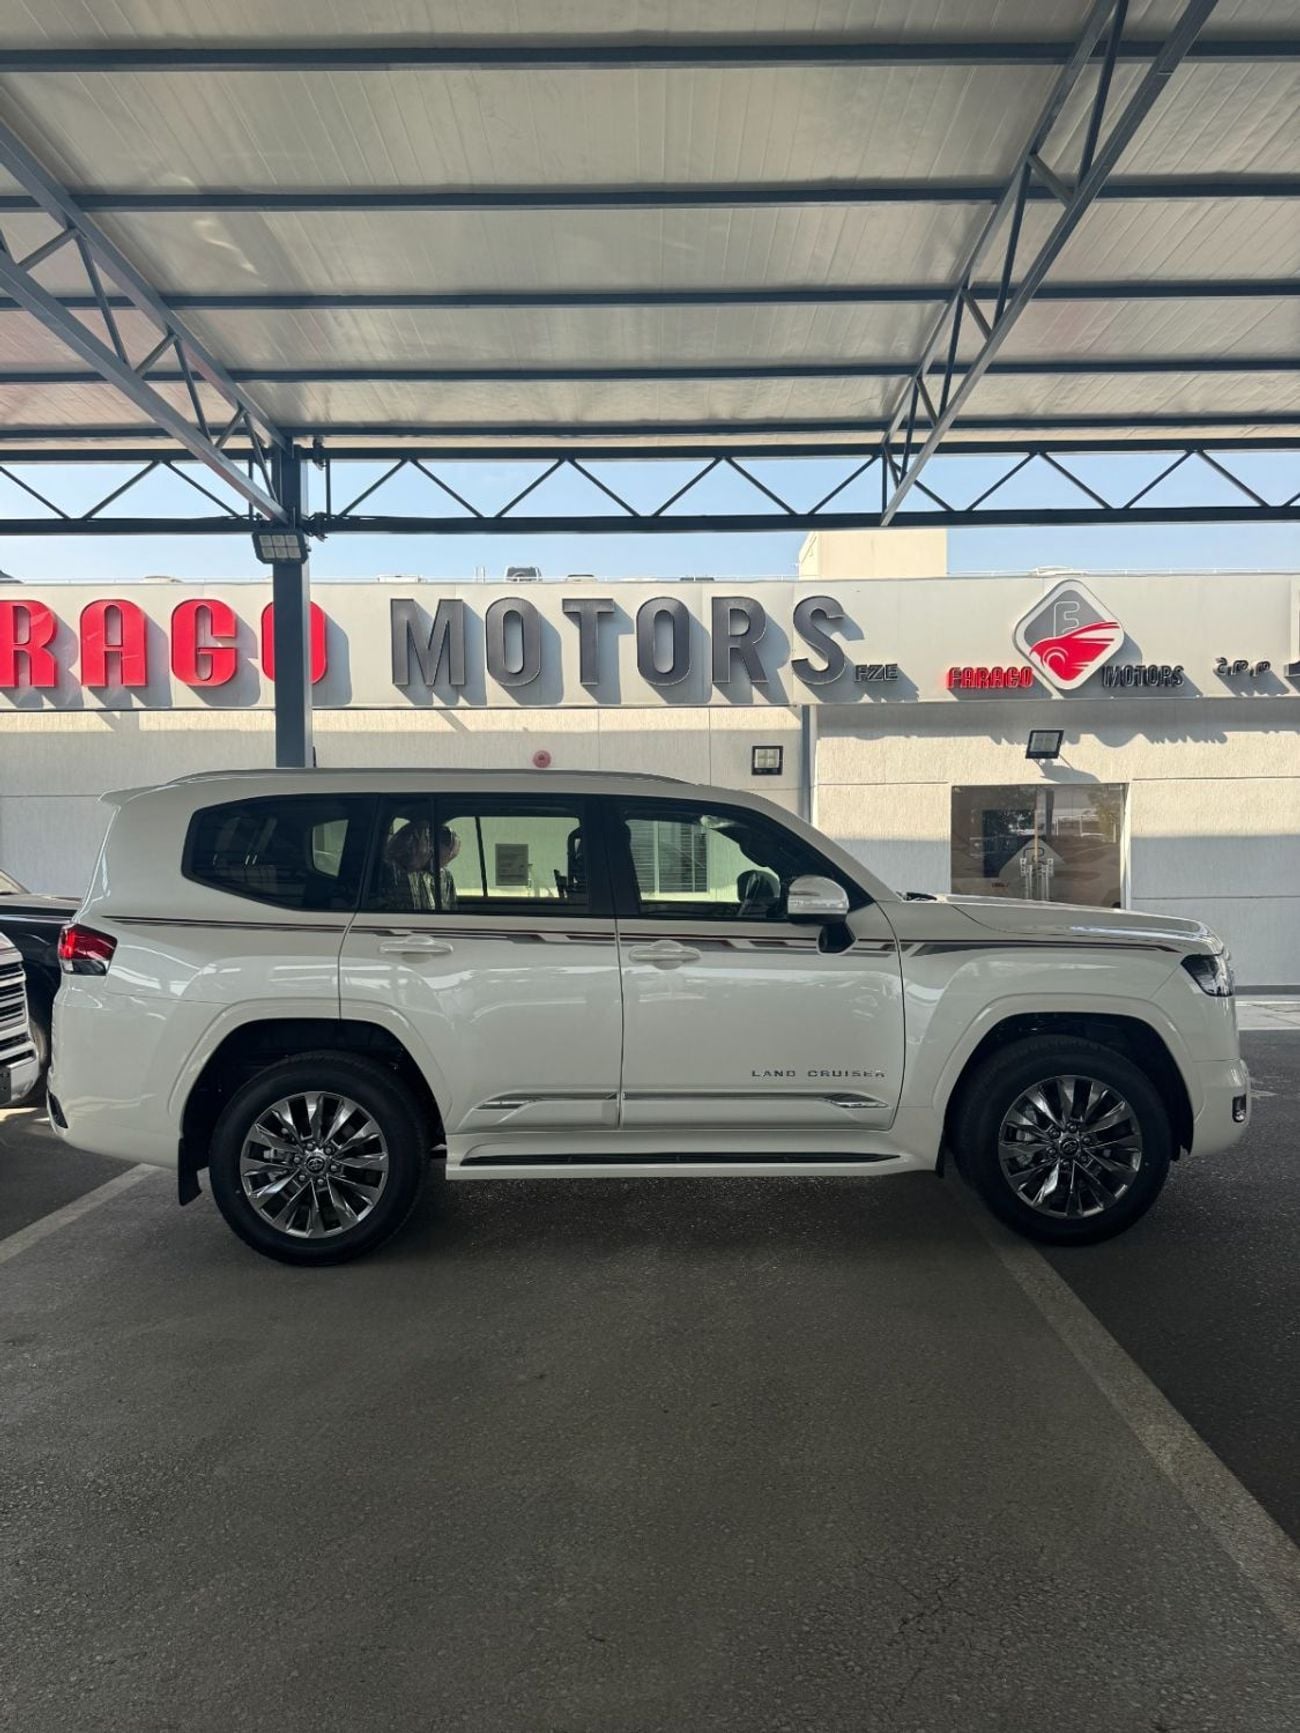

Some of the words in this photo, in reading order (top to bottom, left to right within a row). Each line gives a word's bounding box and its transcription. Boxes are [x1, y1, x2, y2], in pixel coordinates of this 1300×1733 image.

[389, 595, 847, 686] MOTORS
[855, 664, 898, 682] FZE
[946, 666, 1034, 689] FARAGO
[1102, 665, 1185, 688] MOTORS
[752, 1069, 796, 1078] LAND
[807, 1069, 886, 1078] CRUISER
